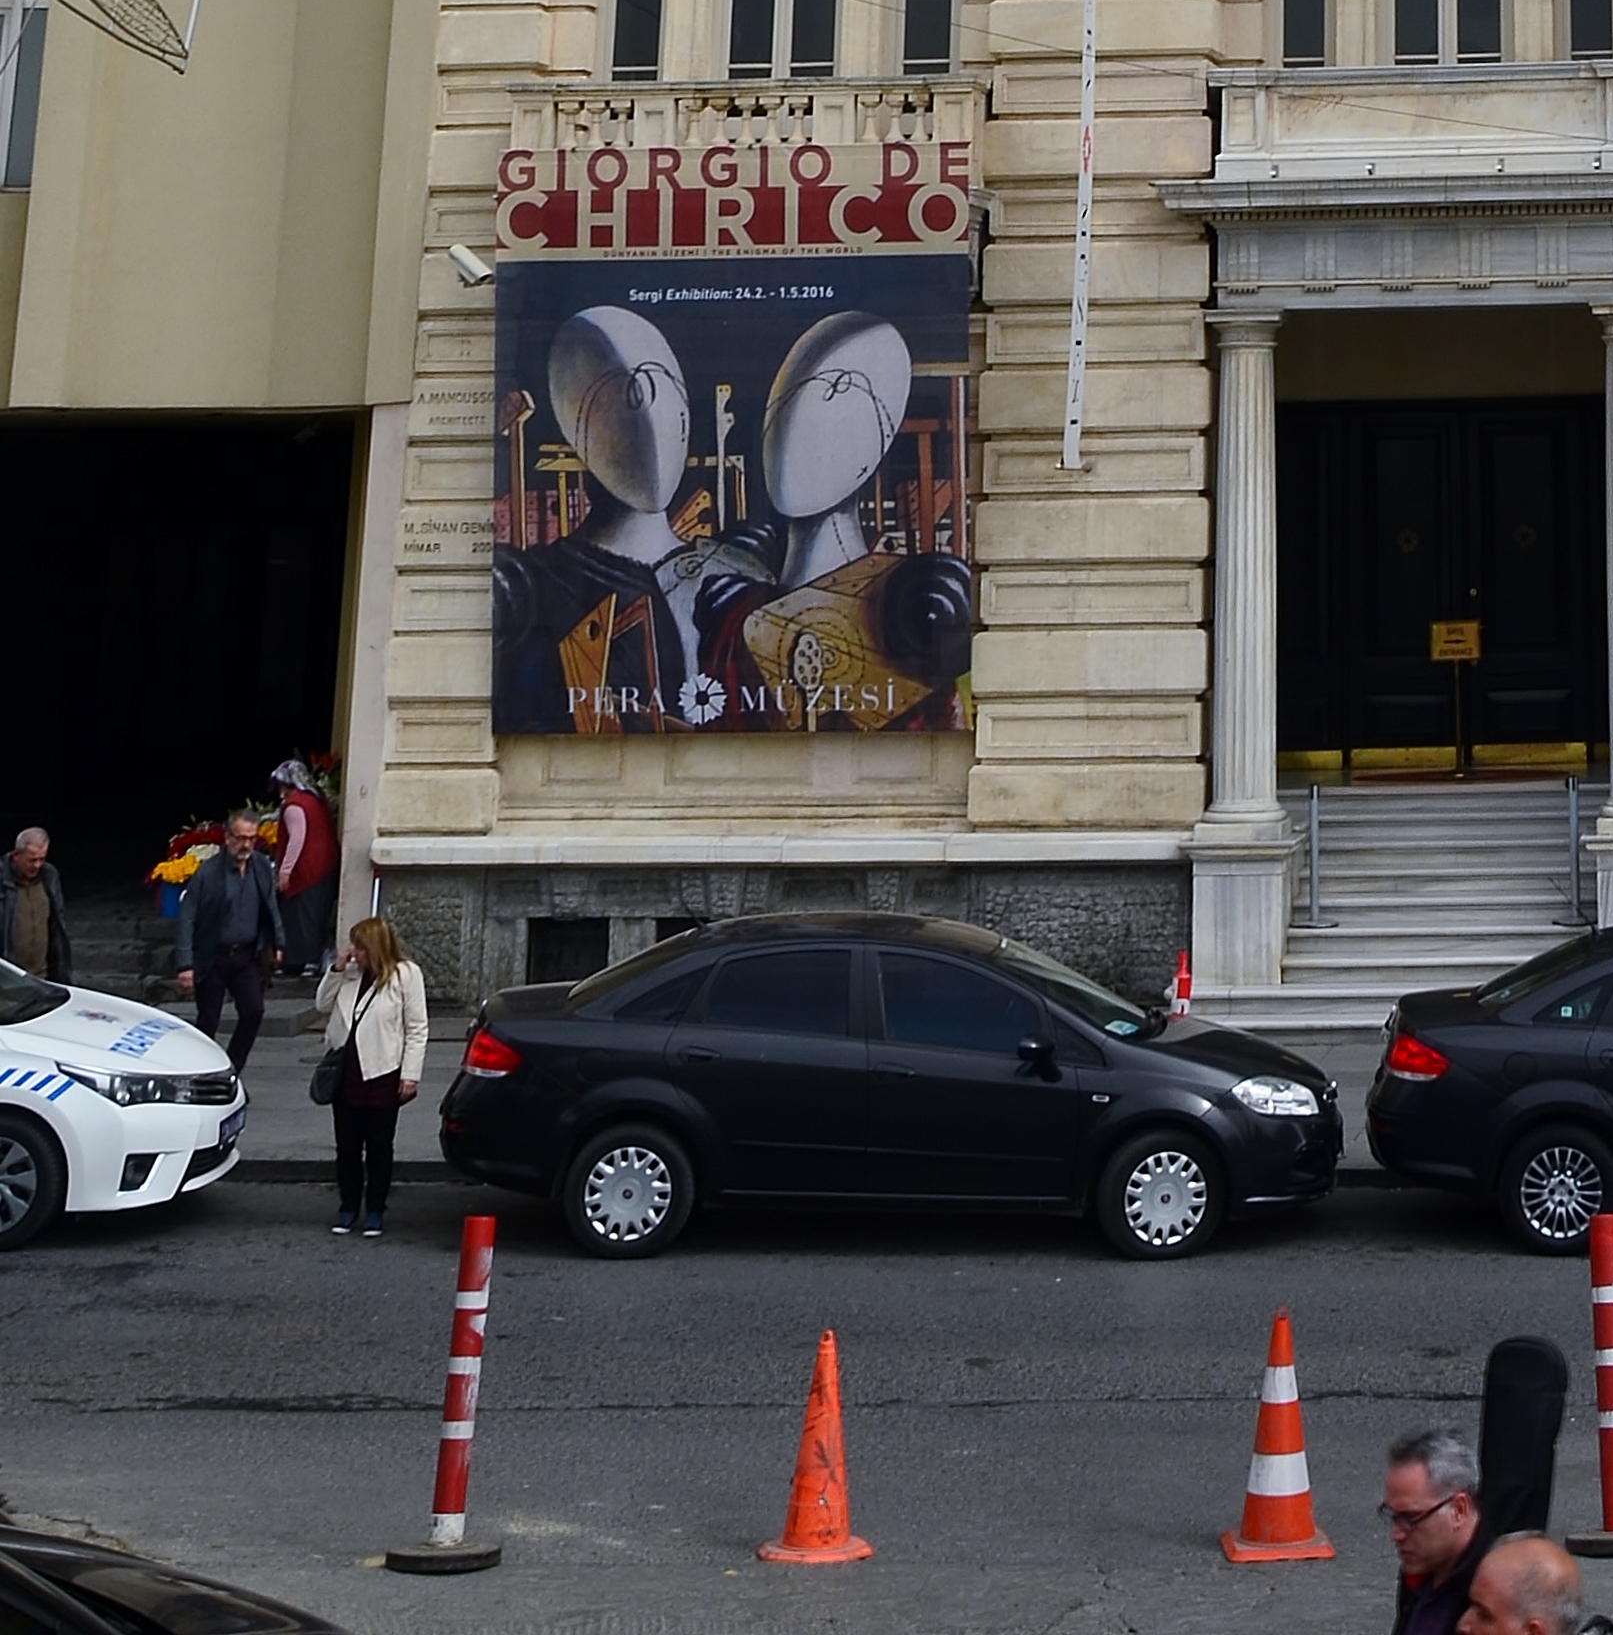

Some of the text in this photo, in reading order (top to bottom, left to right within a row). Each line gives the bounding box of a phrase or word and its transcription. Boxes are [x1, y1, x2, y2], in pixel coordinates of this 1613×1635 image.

[498, 141, 970, 191] GIORGIO DE
[496, 182, 970, 249] CHIRICO
[712, 247, 731, 256] THE
[736, 247, 777, 256] ENIGMA
[782, 246, 796, 256] OF
[801, 246, 820, 255] THE
[826, 245, 864, 254] WORLD
[629, 288, 663, 304] Sergi
[665, 287, 733, 301] Exhibition:
[735, 286, 767, 300] 24.2.
[779, 285, 835, 299] 1.5.2016
[567, 678, 897, 714] PERA MÜZESİ
